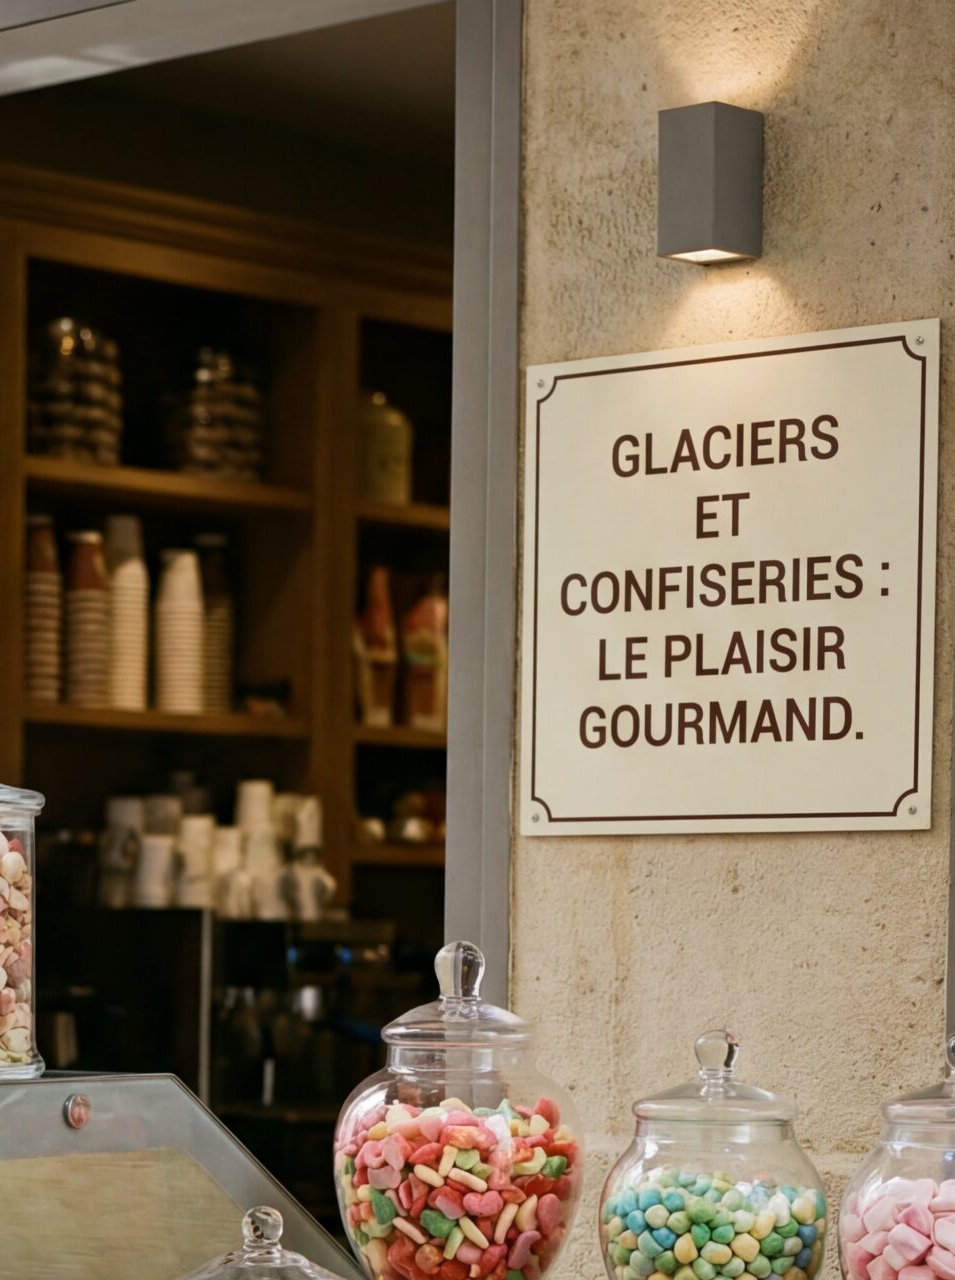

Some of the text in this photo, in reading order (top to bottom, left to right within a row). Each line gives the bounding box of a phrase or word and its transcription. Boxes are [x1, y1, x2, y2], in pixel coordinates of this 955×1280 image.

[611, 414, 839, 478] GLACIERS
[695, 491, 751, 540] ET
[560, 553, 864, 617] CONFISERIES
[598, 625, 846, 681] LE PLAISIR
[579, 696, 864, 750] GOURMAND.
